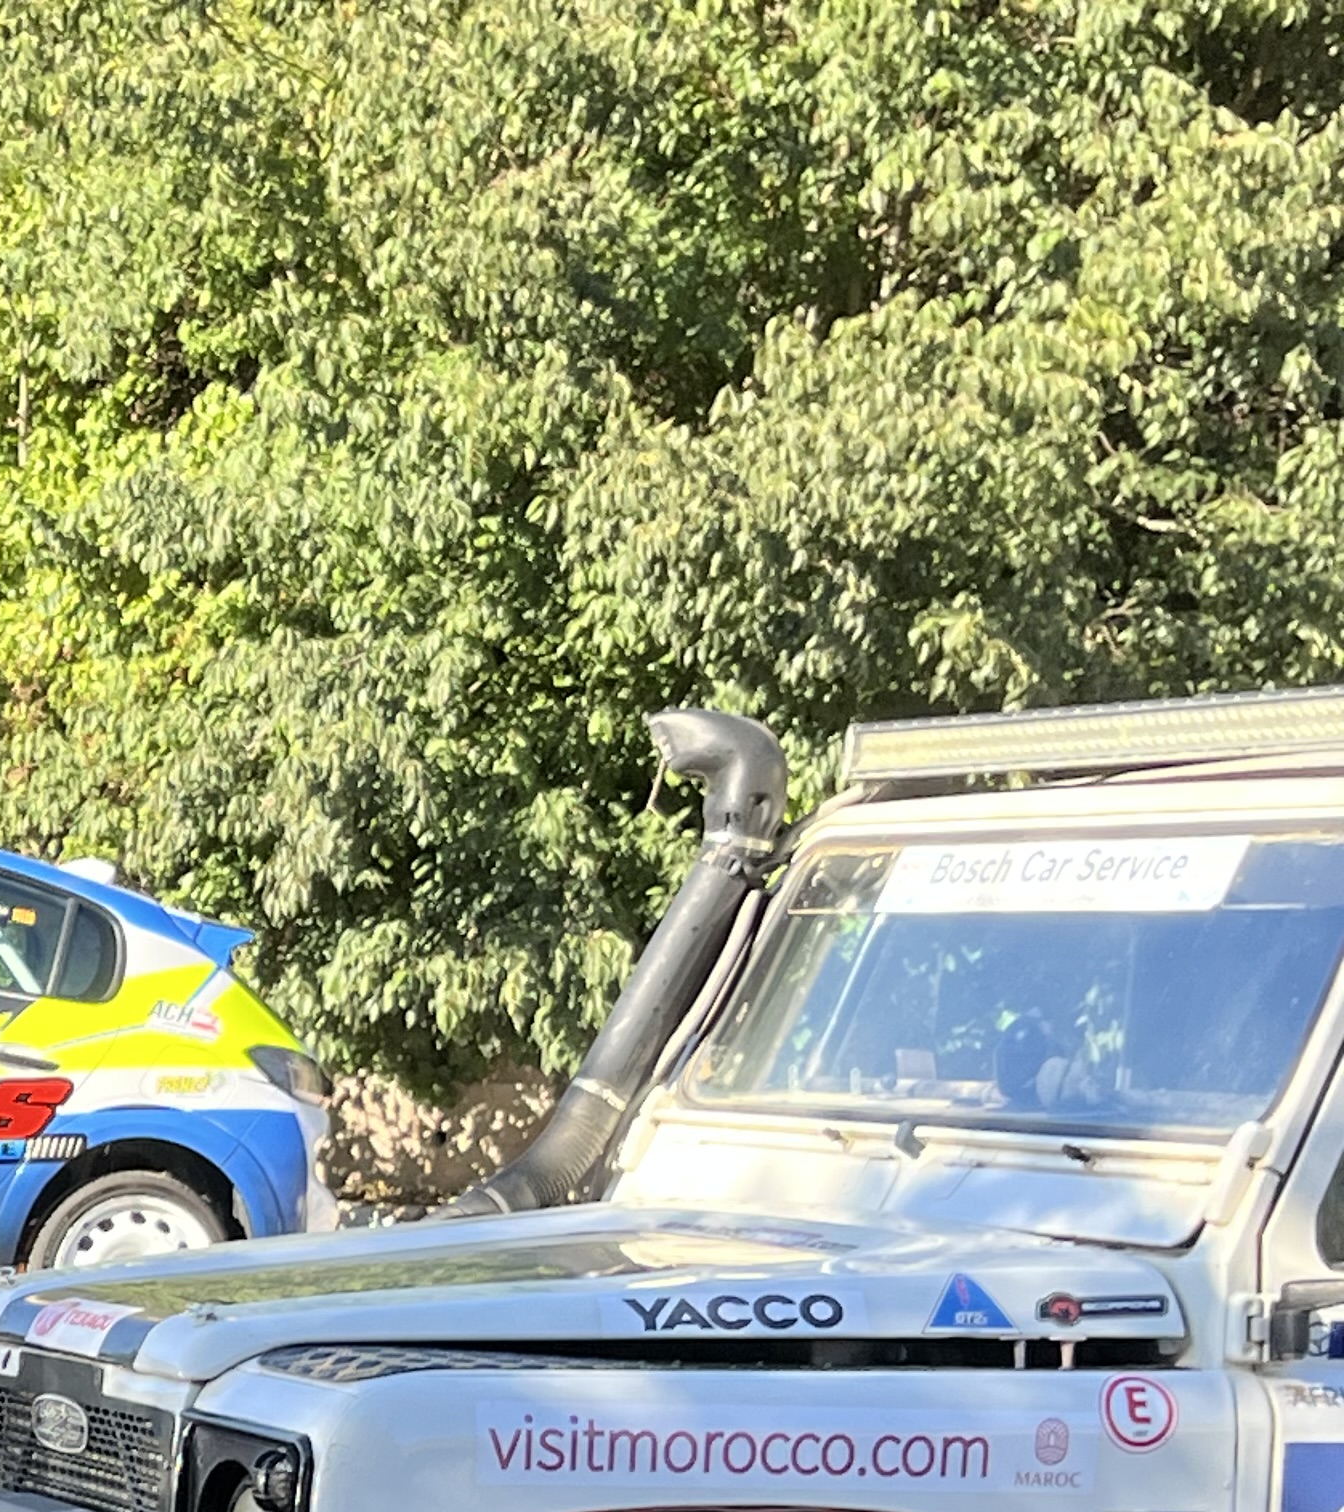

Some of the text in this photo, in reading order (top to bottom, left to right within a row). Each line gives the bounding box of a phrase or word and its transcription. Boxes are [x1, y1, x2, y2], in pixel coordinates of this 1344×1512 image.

[930, 848, 1189, 883] Bosch Car Service
[624, 1294, 844, 1332] YACCO
[489, 1414, 990, 1480] visitmorocco.com
[1014, 1471, 1081, 1489] MAROC
